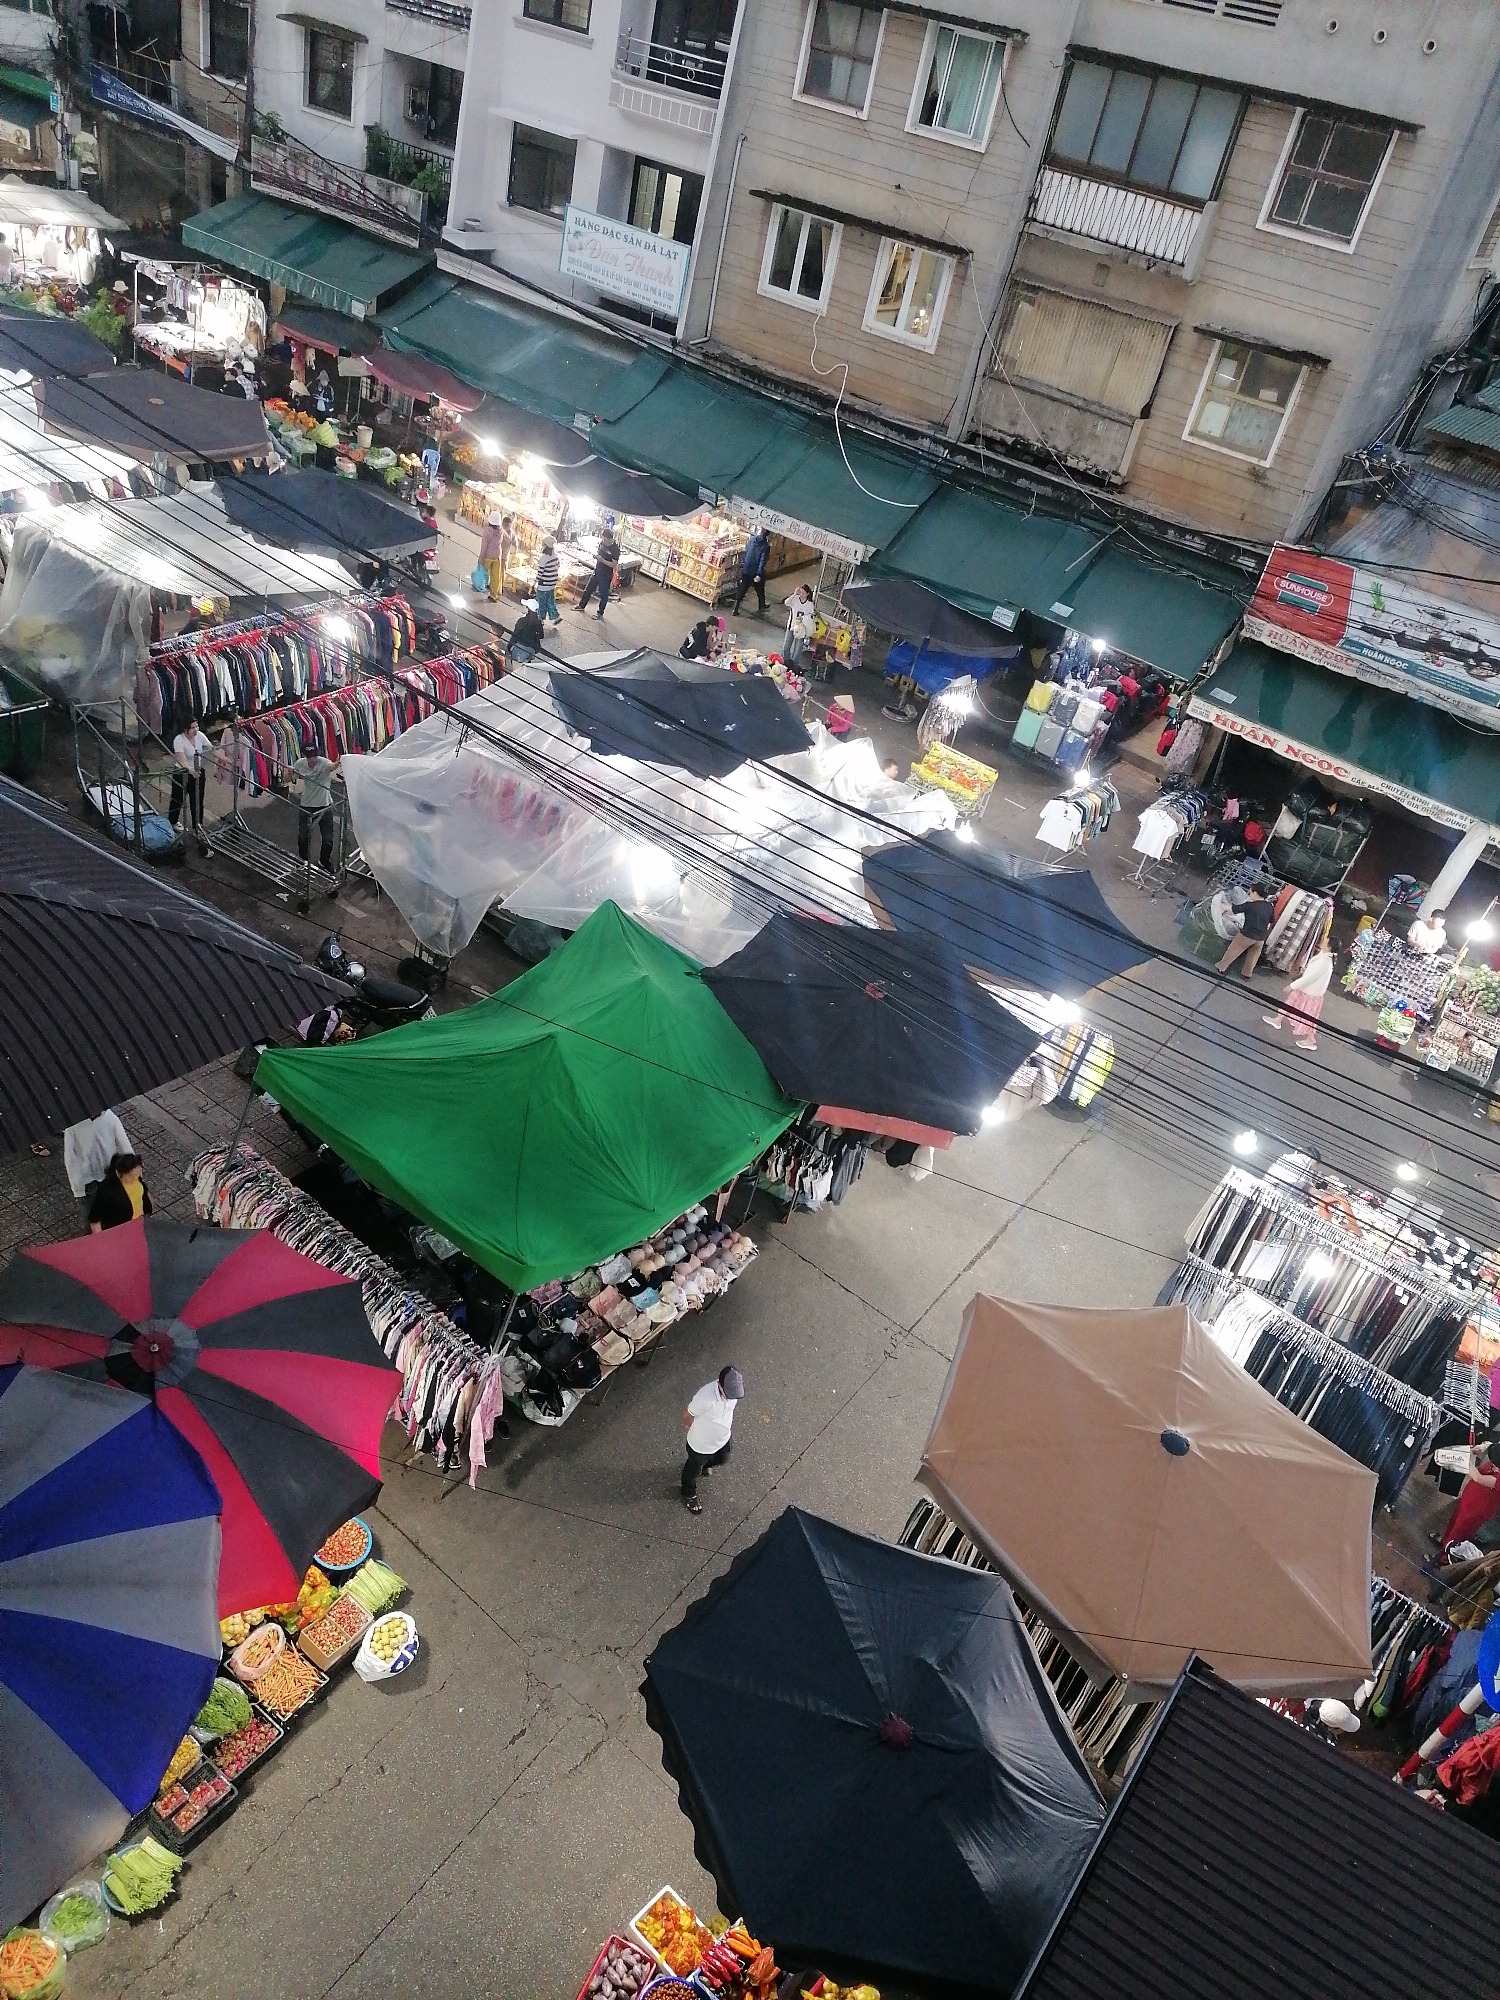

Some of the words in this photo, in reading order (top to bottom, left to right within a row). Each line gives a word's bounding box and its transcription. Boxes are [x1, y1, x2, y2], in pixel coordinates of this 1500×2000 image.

[574, 216, 600, 234] HÀNG
[602, 226, 621, 241] ĐẶC
[623, 232, 642, 248] SẢN
[643, 240, 657, 253] ĐÀ
[660, 247, 679, 260] LẠT
[760, 509, 785, 525] Coffee
[1279, 580, 1328, 602] SUNHOUSE
[1211, 711, 1279, 749] HUÂN
[1284, 744, 1351, 779] NGỌC
[1380, 782, 1409, 798] CHUYÊN
[1411, 795, 1430, 807] KINH
